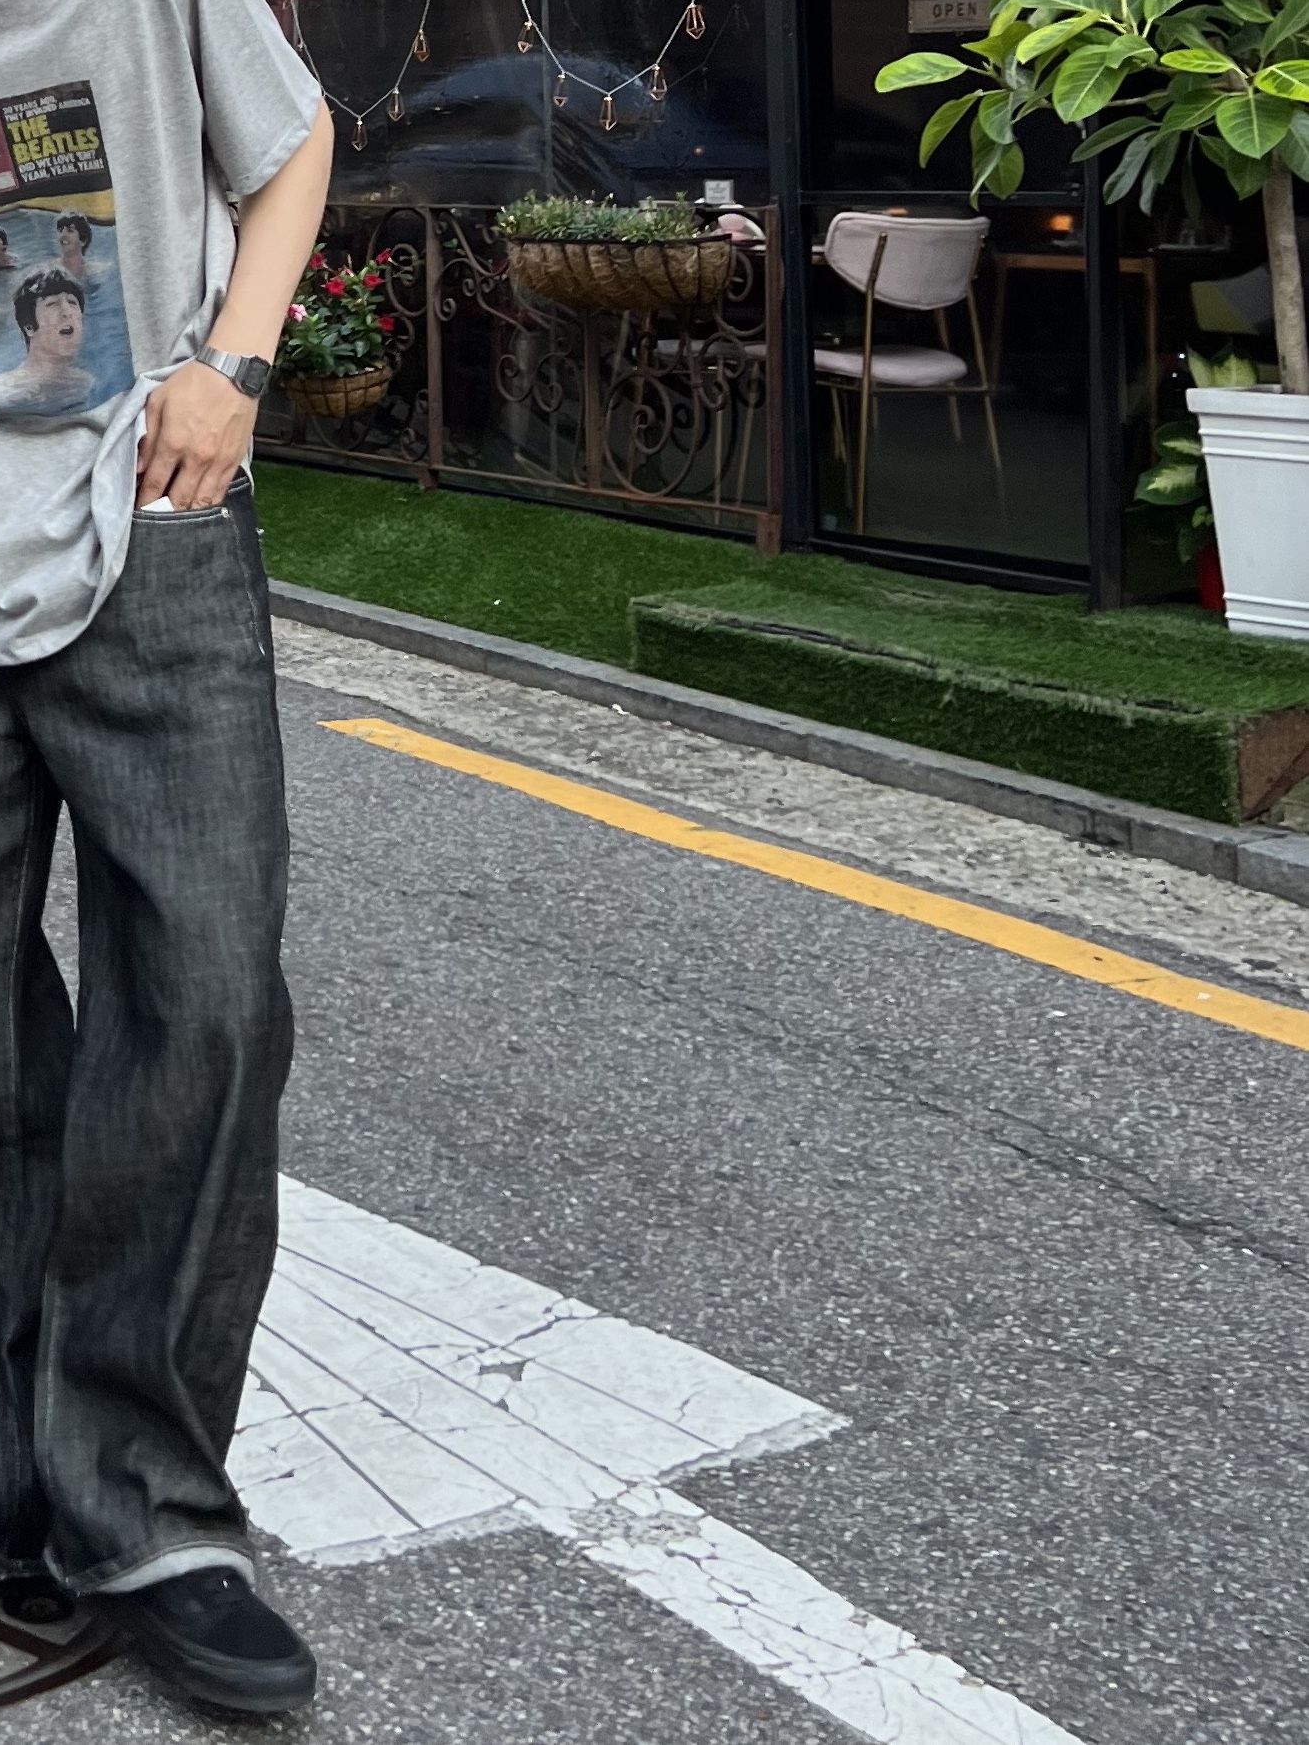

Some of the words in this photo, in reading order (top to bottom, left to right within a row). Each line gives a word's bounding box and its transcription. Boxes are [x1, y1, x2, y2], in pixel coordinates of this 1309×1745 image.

[933, 2, 977, 18] OPEN
[7, 114, 50, 142] THE
[12, 127, 100, 164] BEATLES
[19, 161, 35, 173] DID
[35, 157, 52, 169] WE
[52, 152, 75, 164] LOVE
[77, 158, 104, 172] YEAH!
